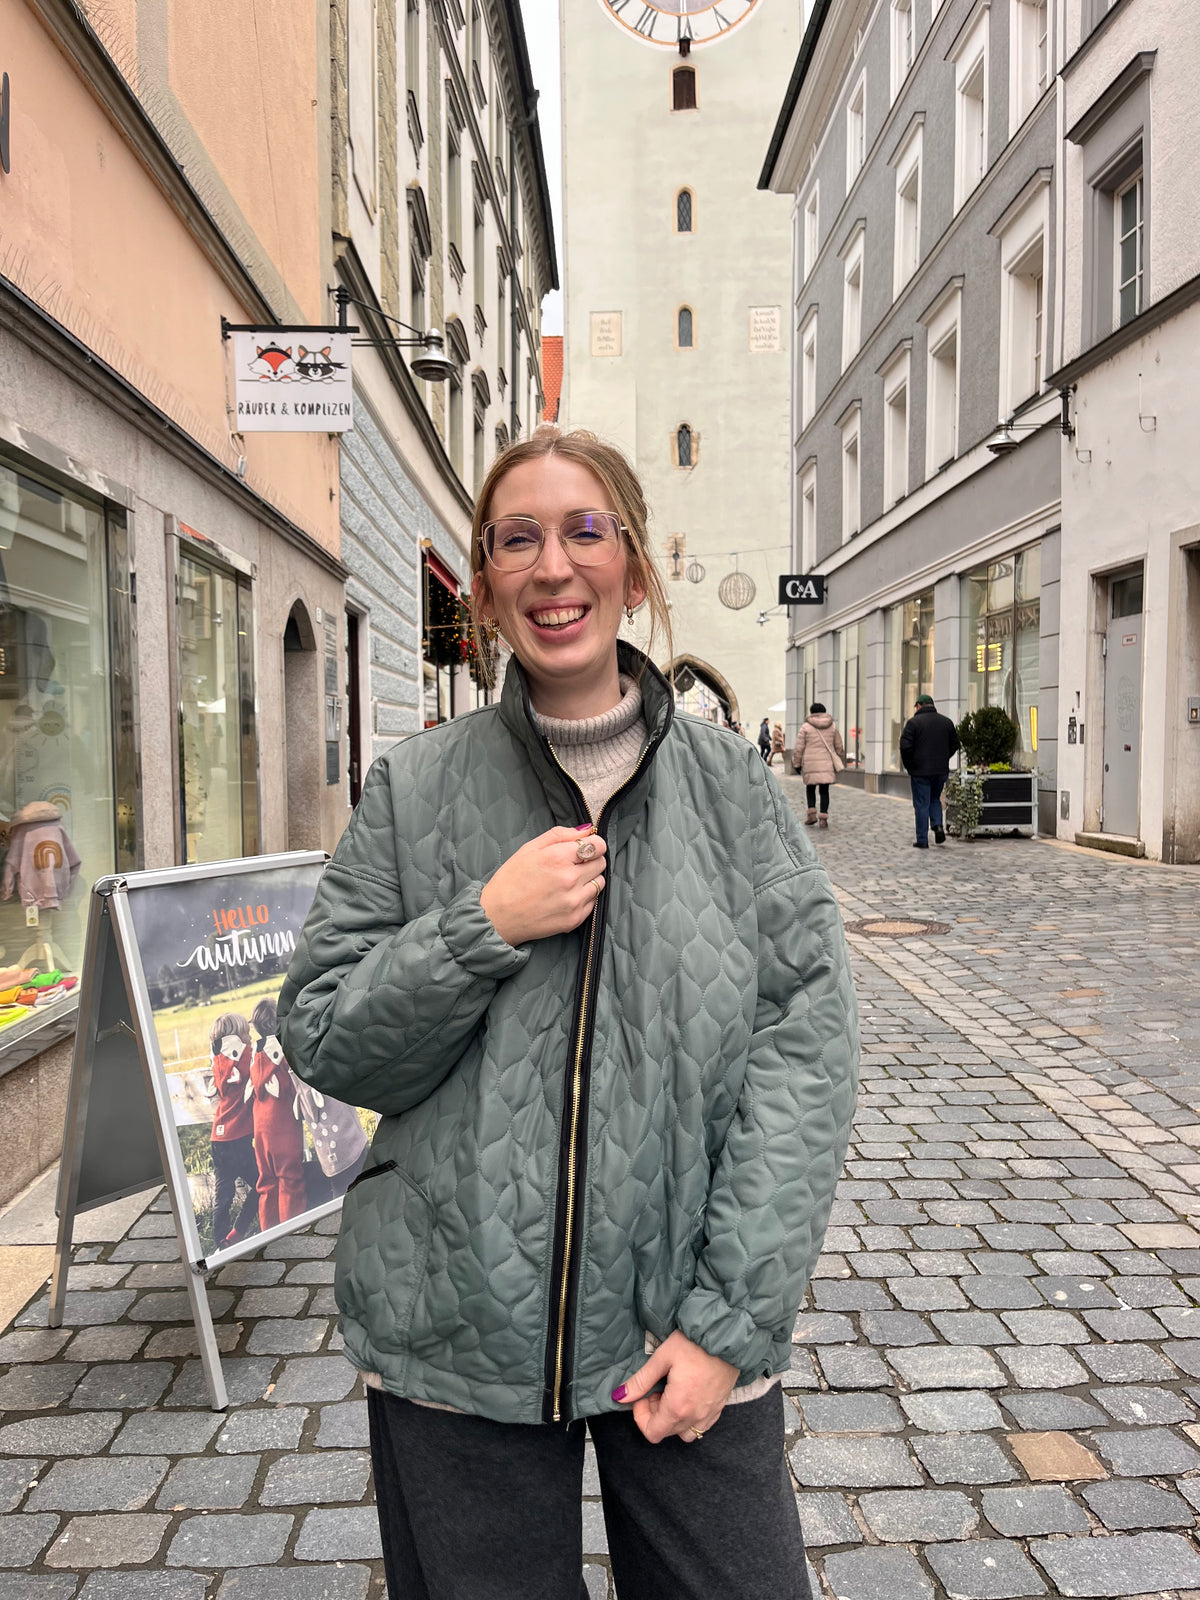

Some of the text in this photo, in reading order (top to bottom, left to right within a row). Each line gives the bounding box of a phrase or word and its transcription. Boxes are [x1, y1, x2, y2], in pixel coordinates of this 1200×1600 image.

[238, 400, 277, 416] RÄUBER
[281, 402, 290, 416] &
[785, 580, 819, 599] C&A
[176, 929, 297, 971] autumn
